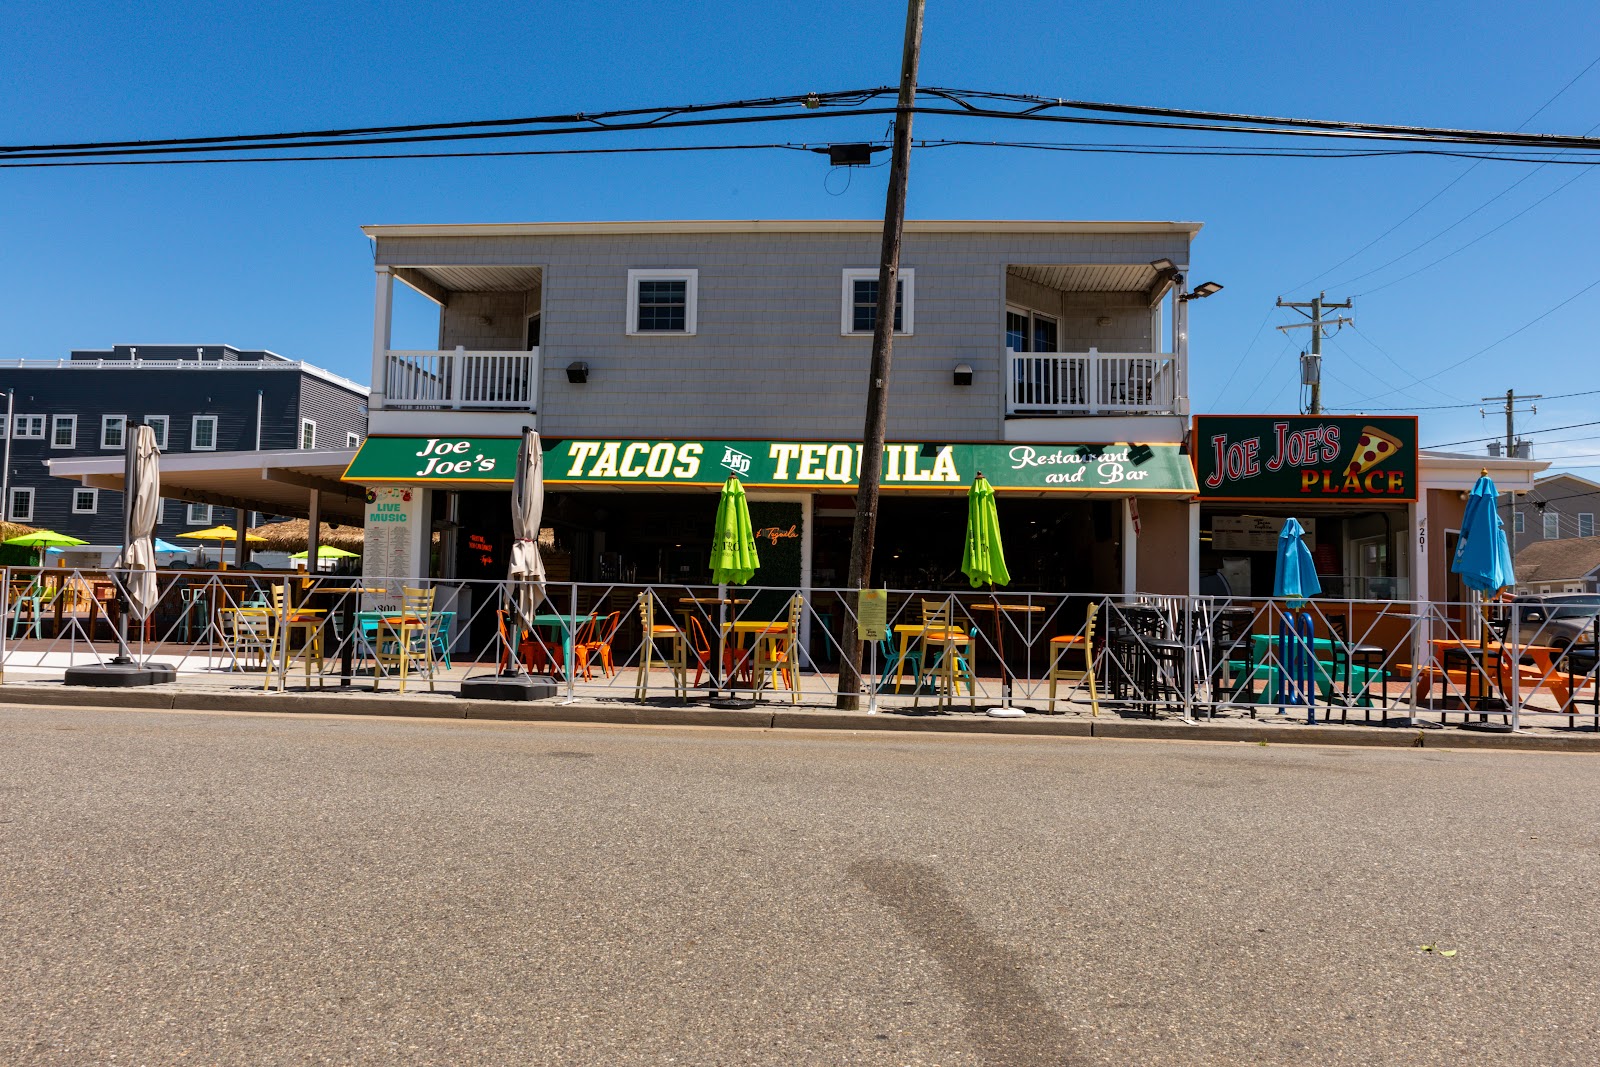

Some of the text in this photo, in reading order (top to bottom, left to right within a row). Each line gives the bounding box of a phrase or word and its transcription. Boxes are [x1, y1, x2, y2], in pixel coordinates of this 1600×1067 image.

[416, 438, 471, 457] Joe
[1009, 445, 1130, 469] Restaurant
[1205, 421, 1340, 488] JOE JOE'S
[416, 454, 496, 476] Joe's
[566, 441, 704, 478] TACOS
[721, 449, 751, 473] AND
[768, 443, 961, 484] TEQILA
[1045, 465, 1087, 484] and
[1097, 462, 1148, 485] Bar
[1300, 469, 1405, 494] PLACE
[369, 513, 407, 522] MUSIC
[377, 503, 401, 512] LIVE
[766, 524, 799, 545] Tequila
